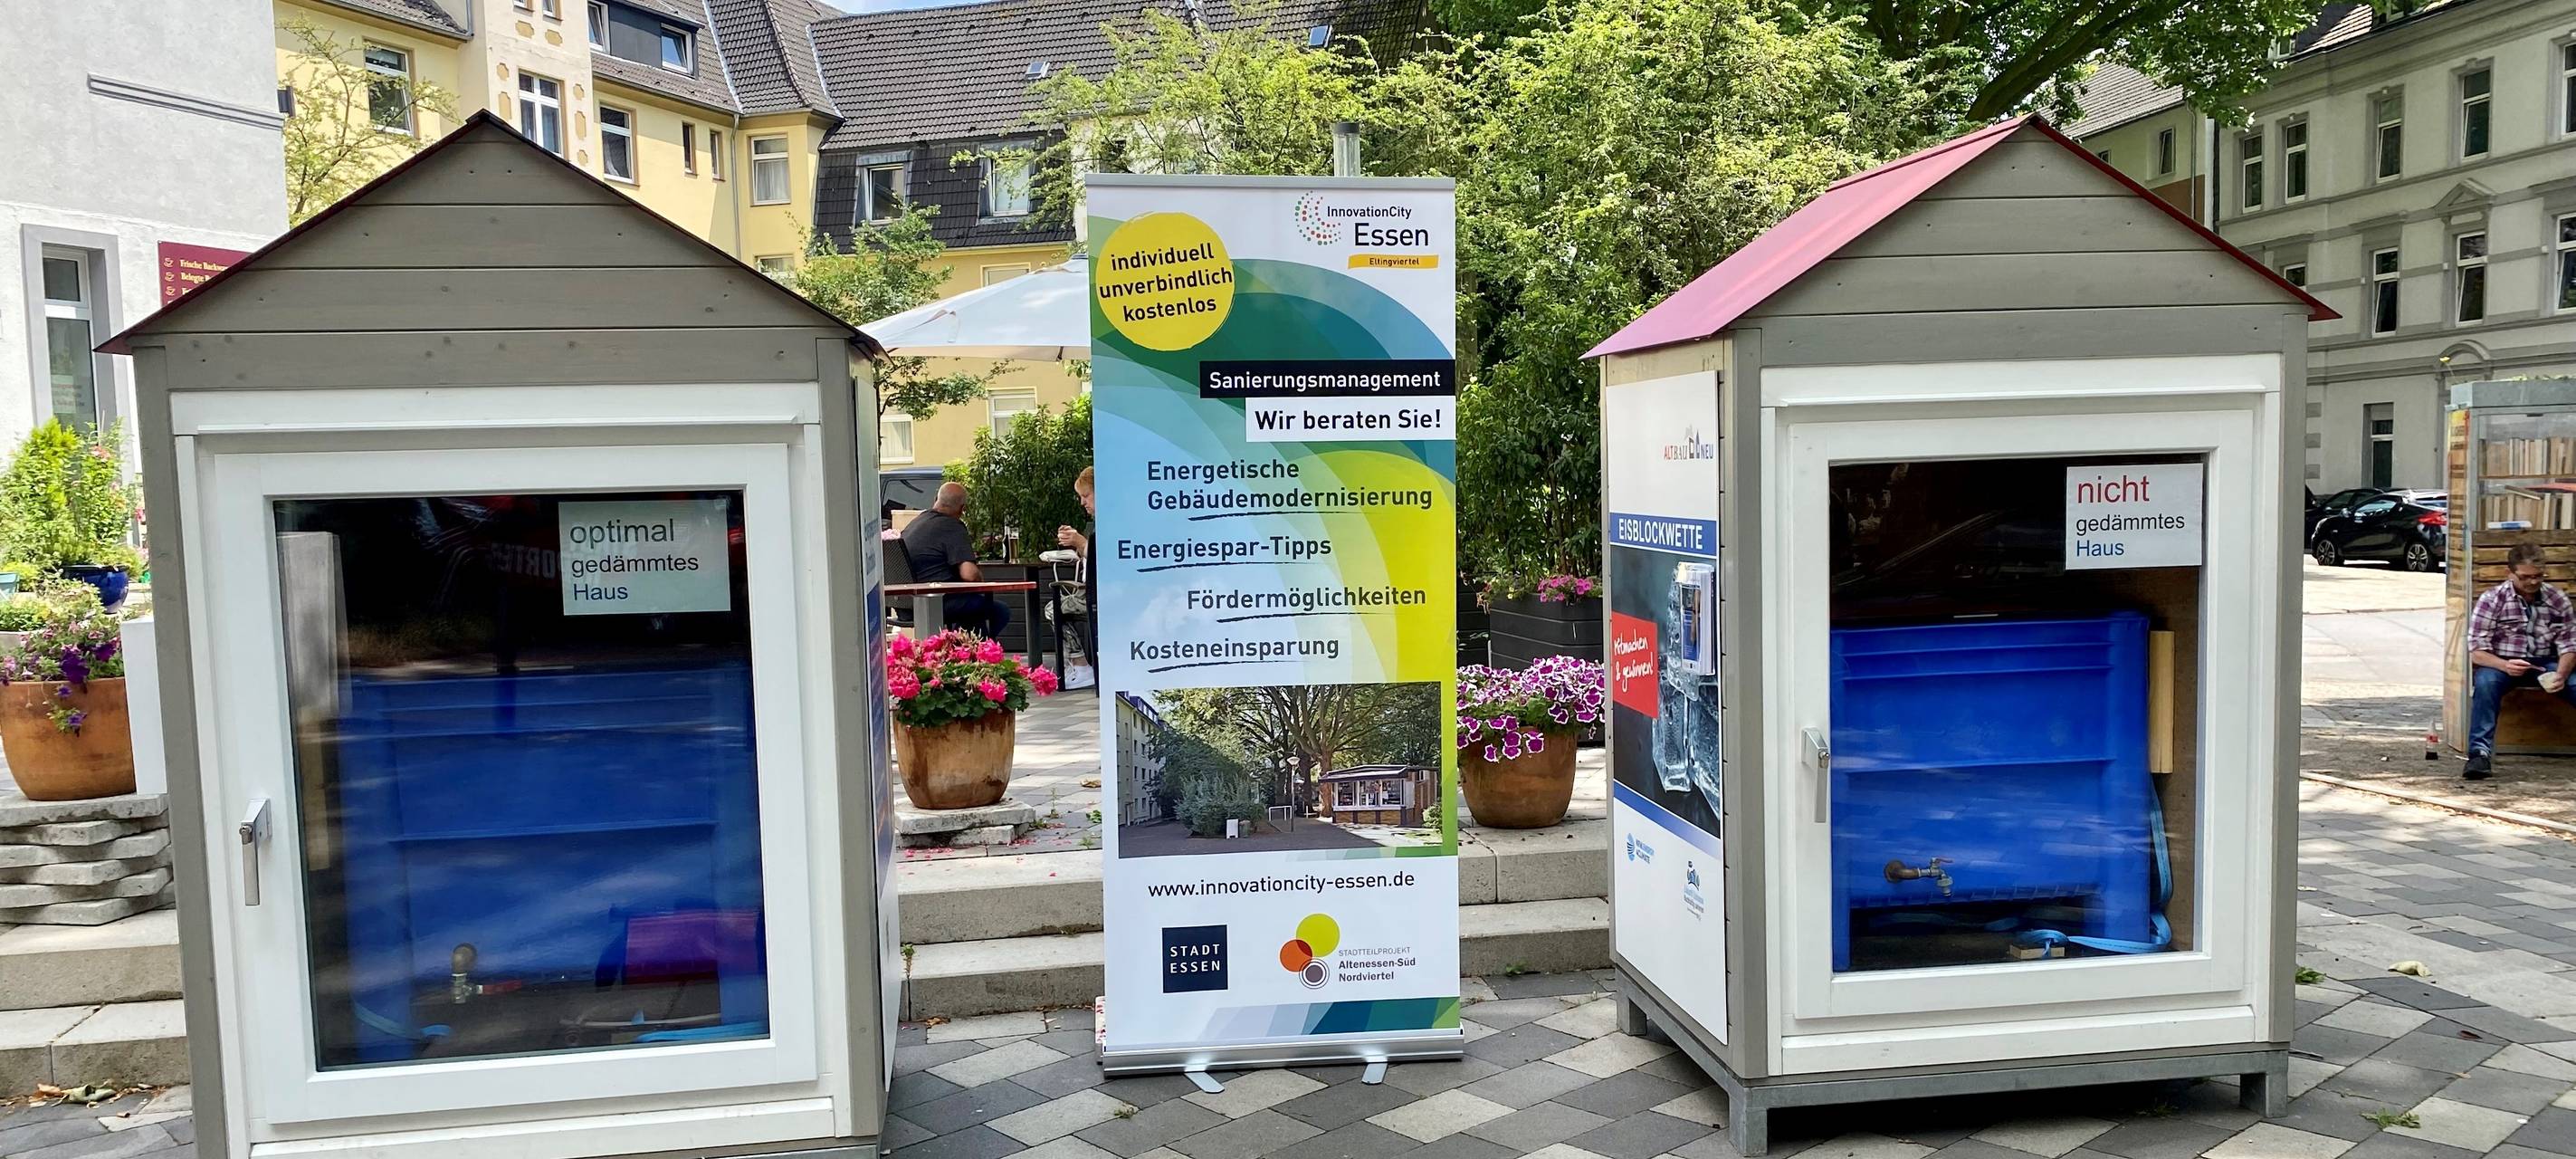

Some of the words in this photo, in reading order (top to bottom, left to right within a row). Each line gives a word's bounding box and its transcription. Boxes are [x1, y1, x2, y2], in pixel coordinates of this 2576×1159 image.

[1327, 206, 1412, 219] InnovationCity
[1354, 222, 1429, 247] Essen
[180, 259, 203, 270] Frische
[1111, 243, 1215, 272] individuell
[1369, 257, 1420, 267] Eltingviertel
[181, 273, 205, 284] Belegte
[1099, 266, 1233, 299] unverbindlich
[1122, 297, 1216, 322] kostenlos
[1209, 370, 1441, 393] Sanierungsmanagement
[1255, 409, 1296, 430] Wir
[1302, 408, 1391, 429] beraten
[1398, 408, 1441, 428] Sie!
[1148, 459, 1299, 484] Energetische
[1148, 487, 1433, 511] Gebäudemodernisierung
[2078, 474, 2150, 503] nicht
[570, 518, 673, 549] optimal
[1618, 518, 1703, 550] EISBLOCKWETTE
[2075, 513, 2185, 536] gedämmtes
[1118, 536, 1331, 561] Energiespar-Tipps
[2076, 541, 2124, 557] Haus
[571, 554, 699, 578] gedämmtes
[573, 583, 628, 600] Haus
[1188, 586, 1426, 610] Fördermöglichkeiten
[1130, 637, 1339, 660] Kosteneinsparung
[1621, 652, 1654, 693] gewinnen!
[1148, 871, 1415, 897] www.innovationcity-essen.de
[1170, 943, 1220, 957] STADT
[1339, 946, 1411, 957] STADTTEILPROJEKT
[1170, 960, 1221, 973] ESSEN
[1339, 957, 1416, 969] Altenessen-Süd
[1339, 972, 1395, 982] Nordviertel
